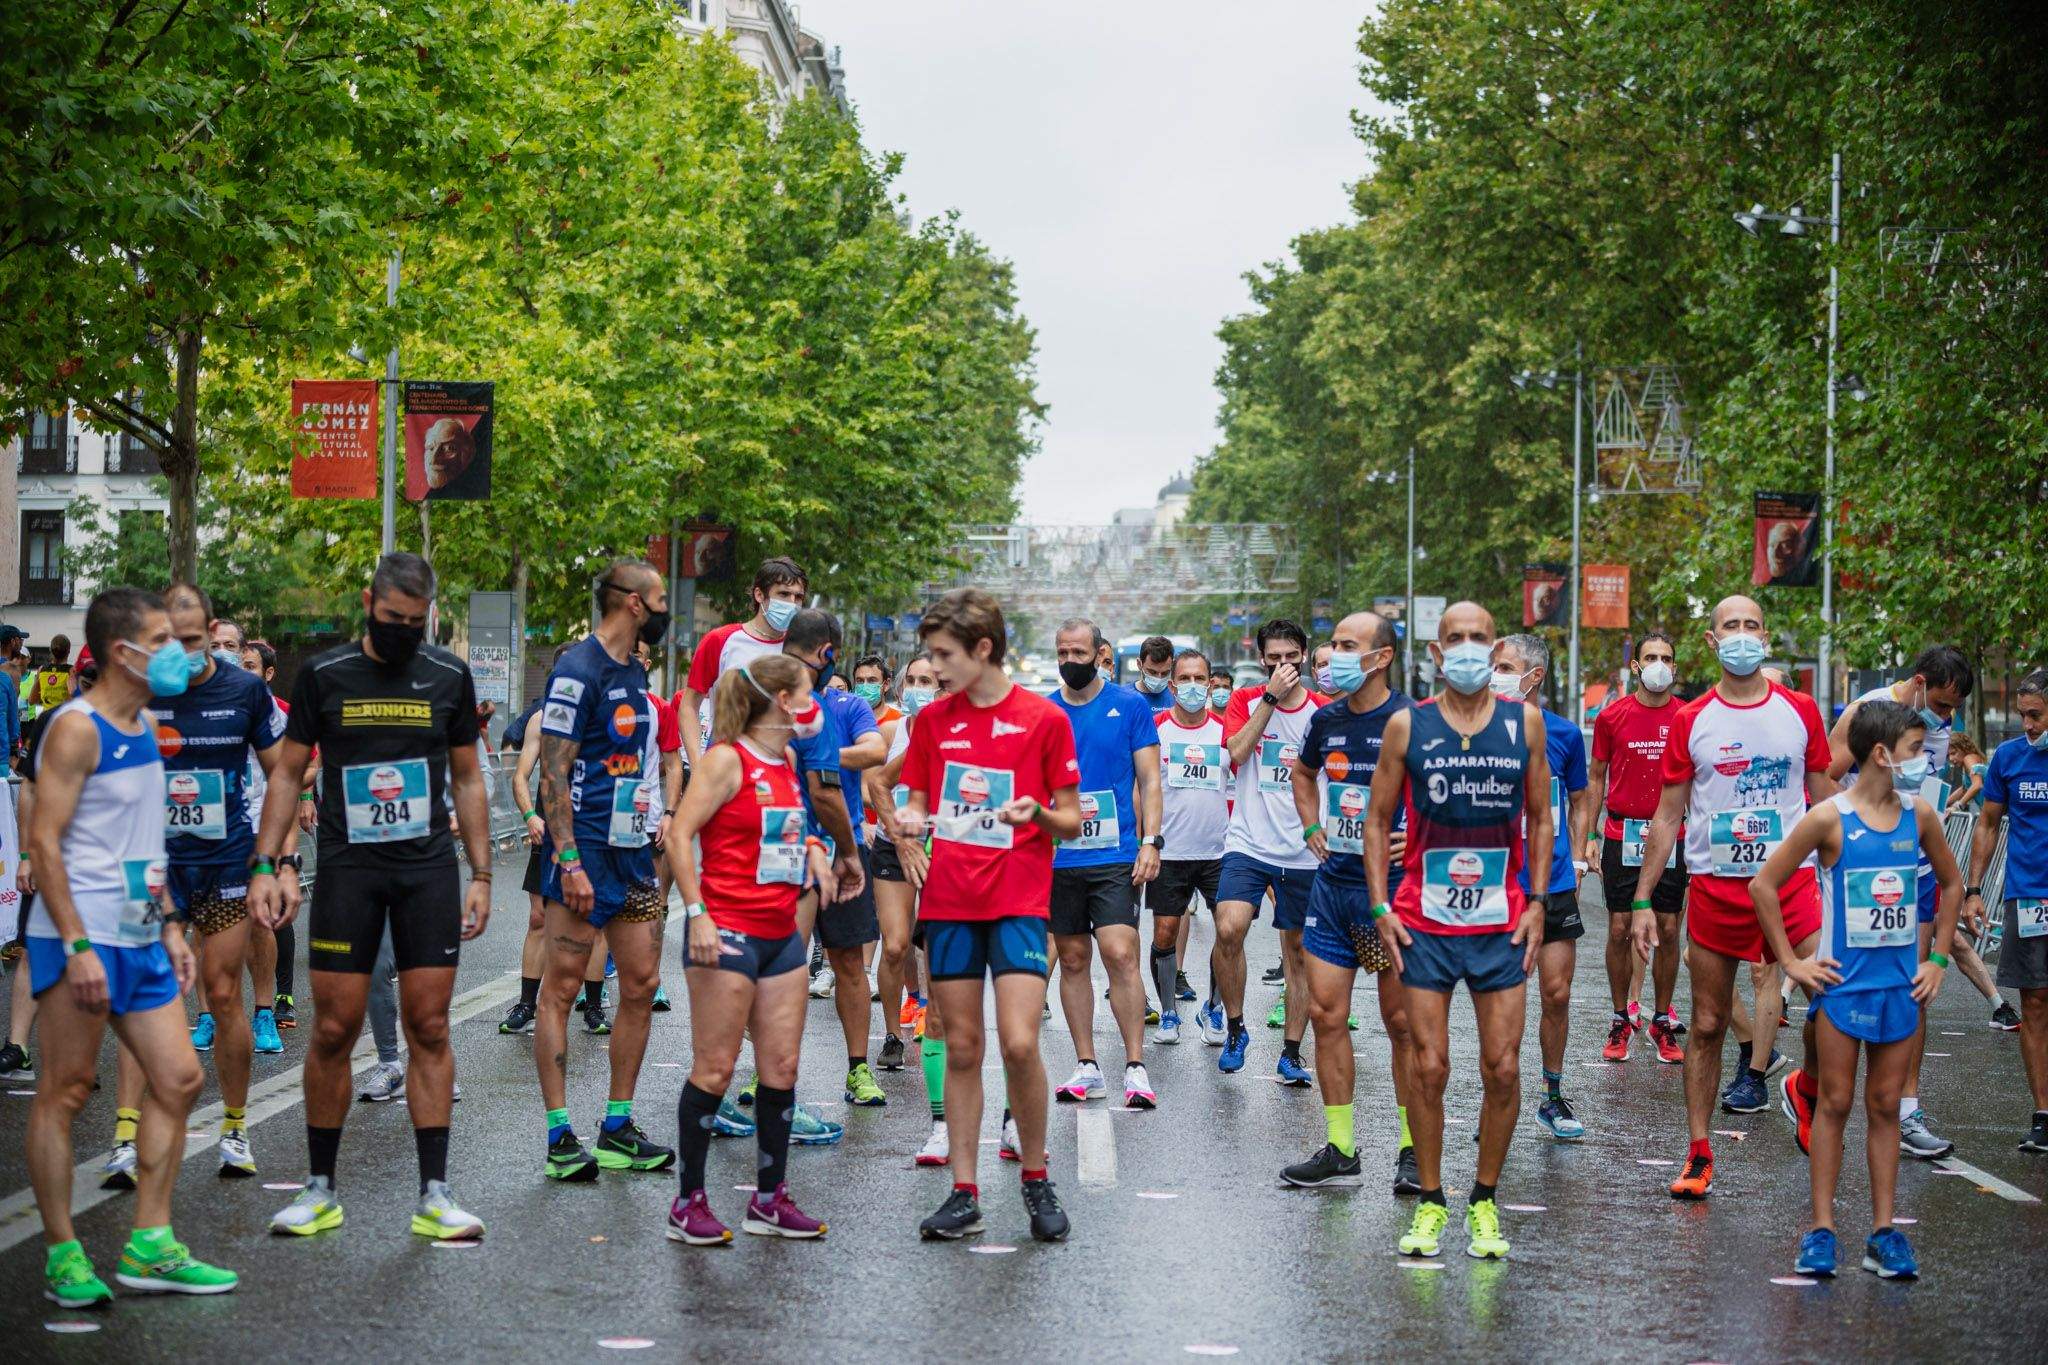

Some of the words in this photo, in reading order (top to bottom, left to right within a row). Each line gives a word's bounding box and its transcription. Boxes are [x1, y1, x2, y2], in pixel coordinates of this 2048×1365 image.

[1183, 764, 1208, 779] 240
[1273, 767, 1293, 783] 12
[1452, 773, 1516, 801] alquiber
[2018, 781, 2048, 791] SUB
[168, 805, 204, 826] 283
[370, 801, 410, 826] 284
[1730, 843, 1767, 863] 232
[1446, 887, 1484, 910] 287
[1869, 907, 1907, 930] 266
